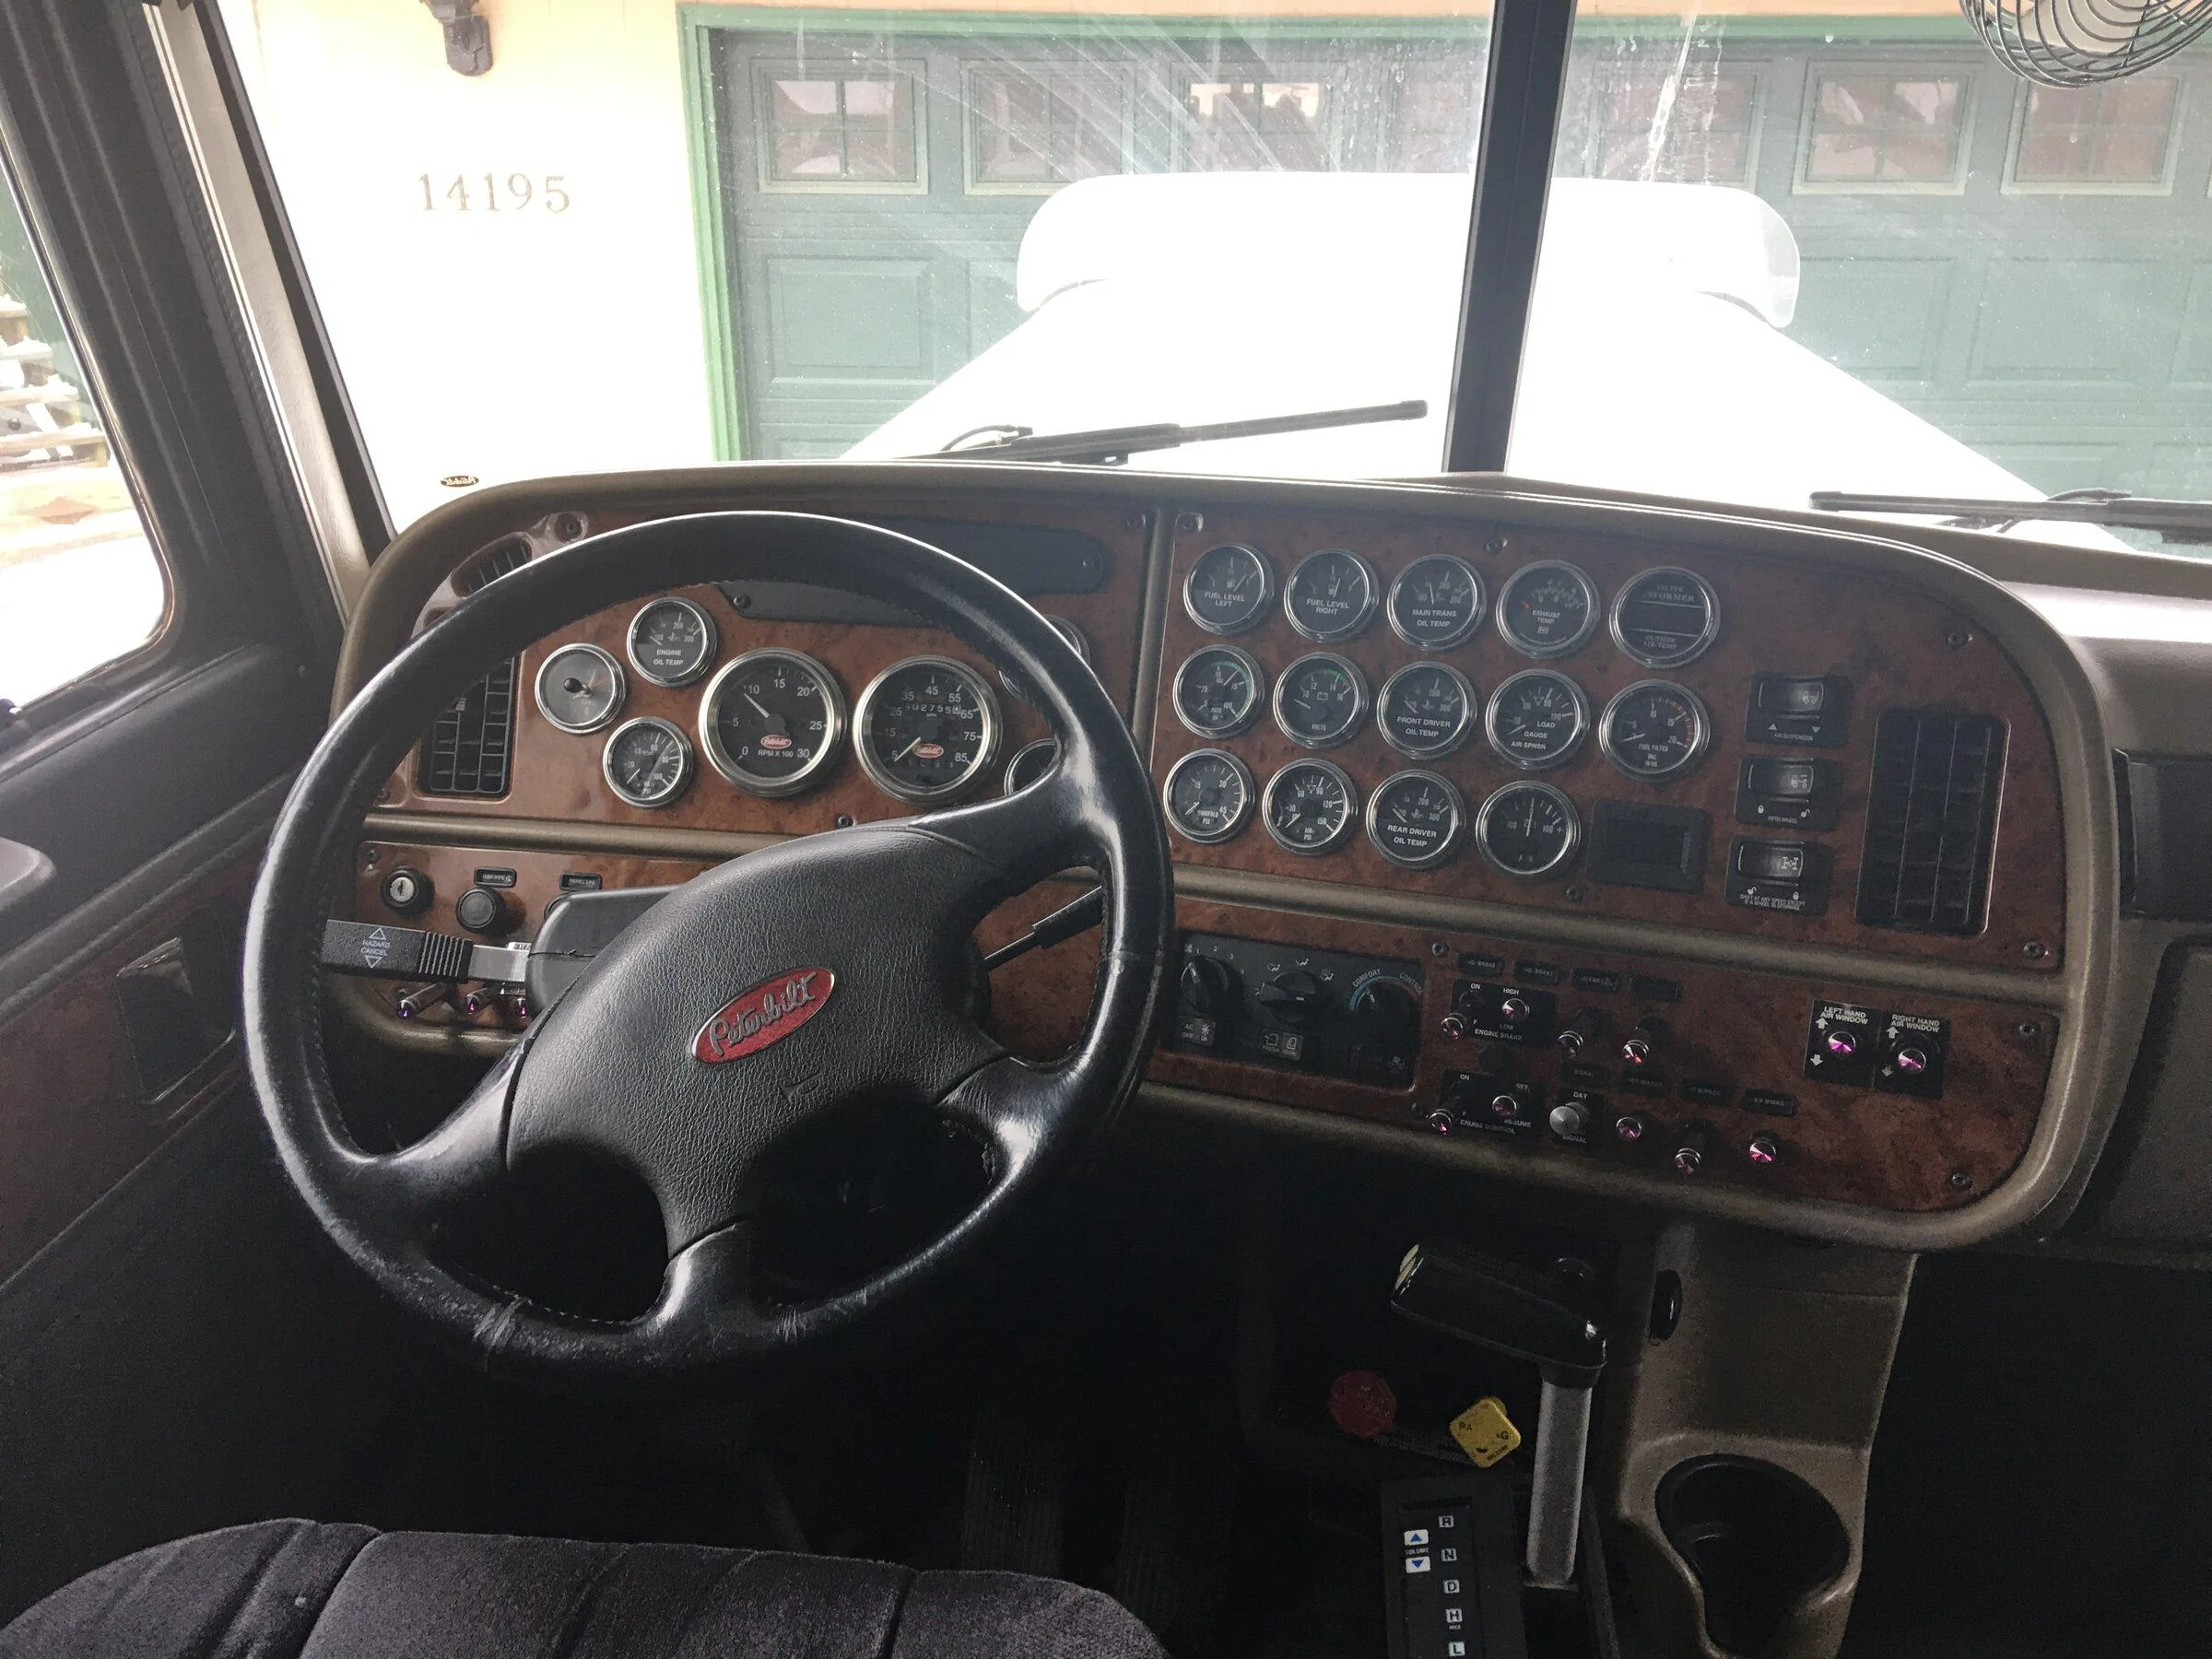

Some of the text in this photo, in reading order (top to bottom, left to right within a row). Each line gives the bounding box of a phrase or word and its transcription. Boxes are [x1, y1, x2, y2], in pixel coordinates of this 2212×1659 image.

[419, 173, 570, 214] 14195
[1205, 591, 1245, 602] FUEL LEVEL
[1306, 598, 1349, 609] FUEL LEVEL
[1532, 610, 1561, 618] EXHAUST
[673, 621, 684, 629] 200
[773, 678, 786, 688] 15
[748, 685, 759, 694] 10
[797, 687, 810, 697] 20
[925, 686, 939, 696] 45
[902, 691, 914, 700] 35
[948, 693, 961, 703] 55
[890, 707, 902, 717] 25
[960, 710, 973, 719] 65
[733, 718, 739, 727] 5
[809, 721, 822, 730] 25
[1397, 716, 1451, 727] FRONT DRIVER
[1667, 718, 1675, 726] 15
[885, 728, 896, 736] 15
[963, 732, 976, 741] 75
[1406, 727, 1439, 737] OIL TEMP
[1524, 731, 1548, 739] GAUGE
[1667, 735, 1677, 744] 20
[742, 747, 748, 756] 0
[797, 748, 810, 759] 30
[955, 753, 968, 762] 85
[1218, 780, 1227, 788] 30
[1297, 790, 1305, 798] 60
[1315, 787, 1324, 795] 90
[1323, 800, 1333, 808] 120
[1418, 797, 1430, 806] 200
[1219, 806, 1228, 814] 45
[1317, 817, 1327, 825] 150
[1387, 825, 1437, 838] REAR DRIVER
[1406, 838, 1428, 847] TEMP
[362, 939, 391, 948] HAZARD
[360, 947, 388, 956] CANCEL
[1352, 969, 1424, 996] COMFORT CONTROL
[709, 971, 817, 1056] Peterbilt
[1824, 1006, 1866, 1018] LEFT HAND
[1820, 1011, 1868, 1025] AIR WINDOW
[1891, 1014, 1940, 1027] RIGHT HAND
[1890, 1019, 1940, 1033] AIR WINDOW
[1475, 1028, 1523, 1041] ENGINE BRAKE
[1573, 1091, 1588, 1100] DAY
[1460, 1119, 1516, 1135] CRUISE CONTROL
[1562, 1135, 1587, 1144] SIGNAL
[1441, 1516, 1453, 1526] R
[1443, 1549, 1454, 1560] N
[1446, 1581, 1457, 1592] D
[1448, 1610, 1460, 1621] H
[1453, 1643, 1463, 1655] L
